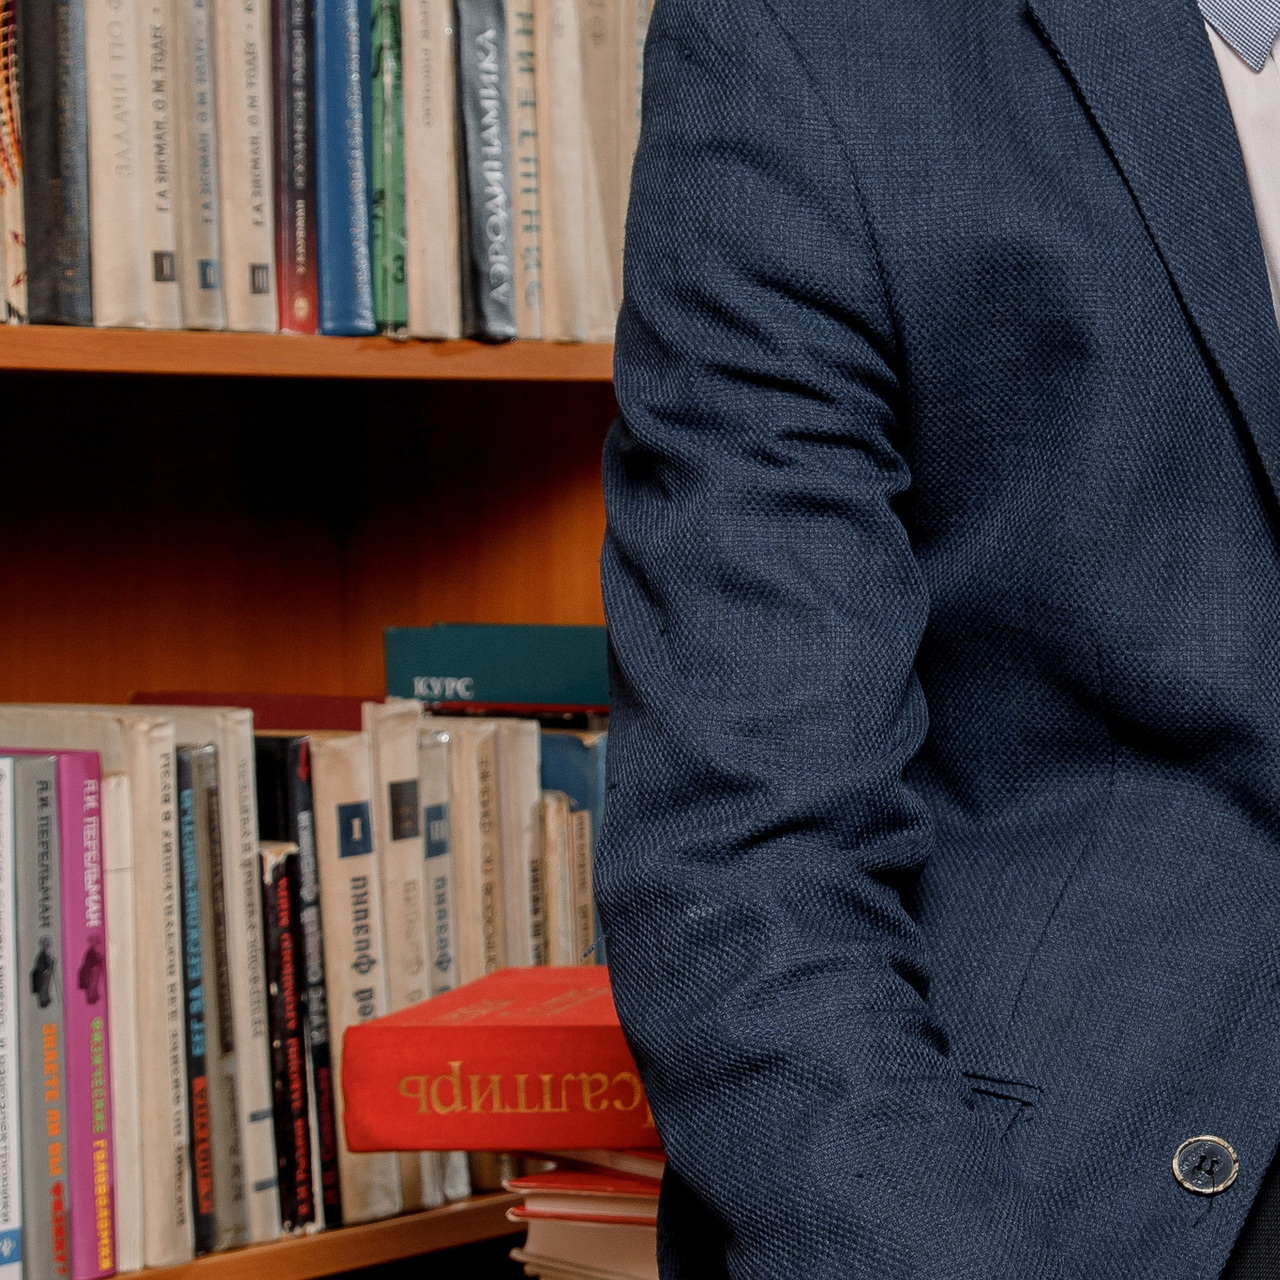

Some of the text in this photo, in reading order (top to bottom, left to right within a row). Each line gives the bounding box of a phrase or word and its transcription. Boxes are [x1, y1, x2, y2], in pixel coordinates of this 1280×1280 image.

[106, 20, 125, 61] ПО
[110, 72, 133, 179] ЗАДАЧИ
[474, 27, 512, 303] АЭРОДИНАМИКА
[514, 11, 542, 310] ЭЙНШТЕЙН
[413, 676, 475, 699] КУРС
[36, 815, 52, 928] ПЕРЕЛЬМАН
[82, 815, 102, 928] ПЕРЕЛЬМАН
[276, 876, 291, 928] МИРА
[349, 875, 378, 976] физики
[432, 876, 453, 974] физики
[188, 984, 205, 1015] ЗА
[190, 1017, 206, 1057] БЕГ
[42, 1022, 60, 1104] ЗНАЕТЕ
[397, 1061, 649, 1122] салтирь
[46, 1109, 62, 1137] ЛИ
[47, 1142, 63, 1177] ВЫ
[90, 1016, 114, 1272] ФИЗИЧЕСКИЕ ГОЛОВОЛОМКИ
